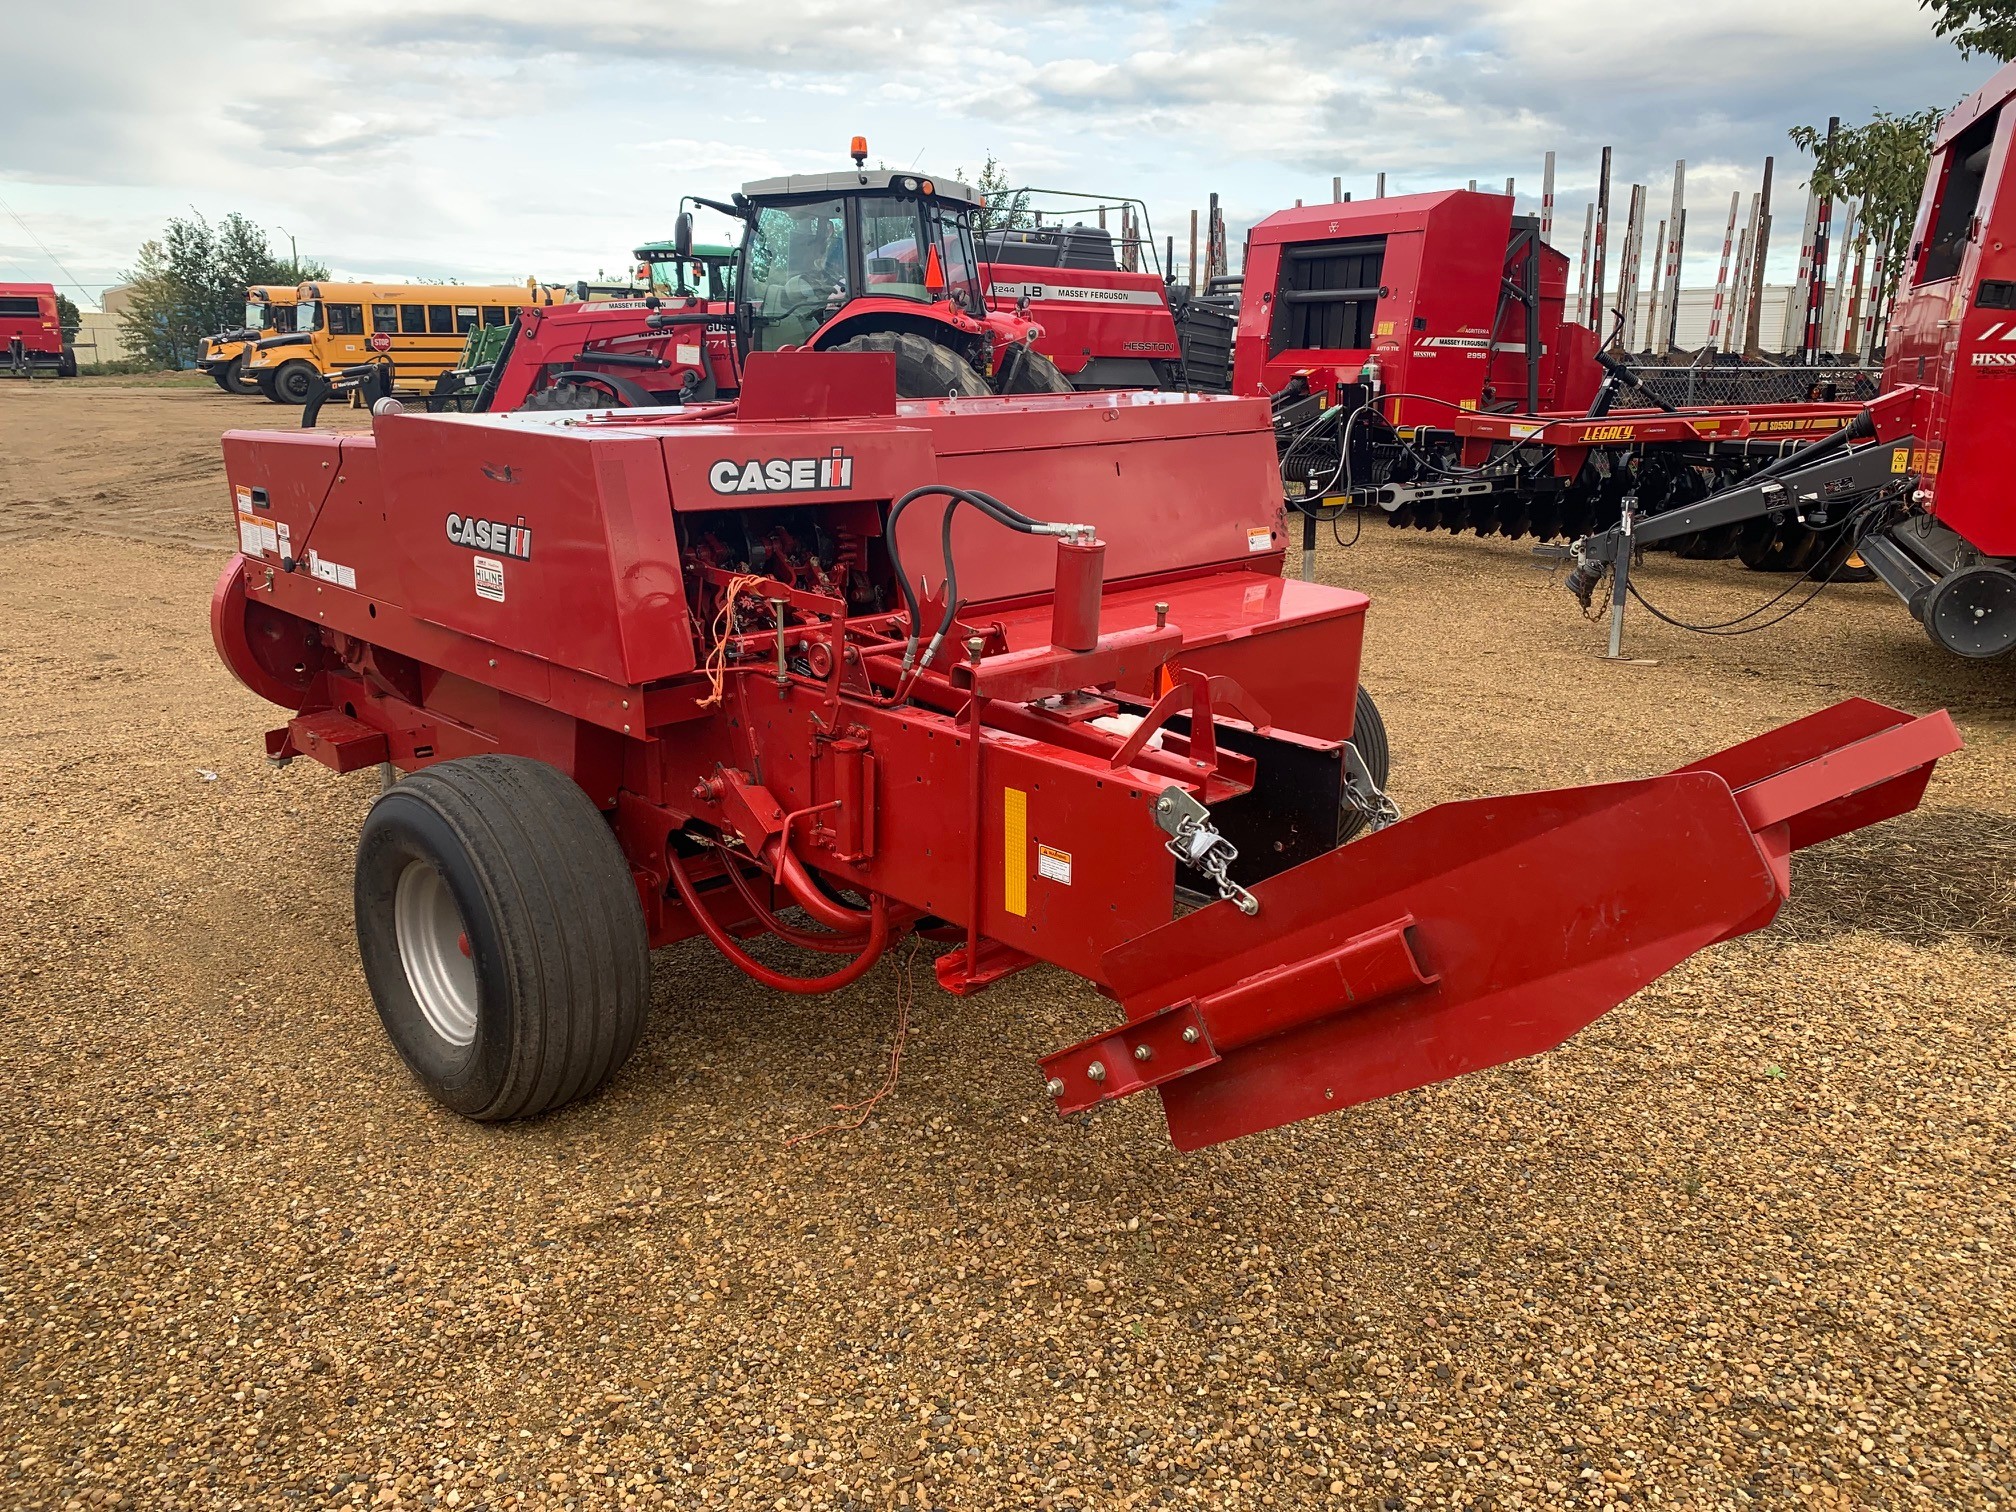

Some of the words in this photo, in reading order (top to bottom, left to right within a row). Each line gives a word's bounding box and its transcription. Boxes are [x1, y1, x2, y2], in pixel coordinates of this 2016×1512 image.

[1023, 286, 1043, 297] LB
[1058, 289, 1088, 298] MASSEY
[1090, 291, 1129, 300] FERGUSON
[374, 338, 389, 346] STOP
[1123, 342, 1174, 351] HESSTON
[1584, 426, 1633, 440] LEGACY
[710, 460, 817, 493] CASE
[446, 513, 507, 553] CASE
